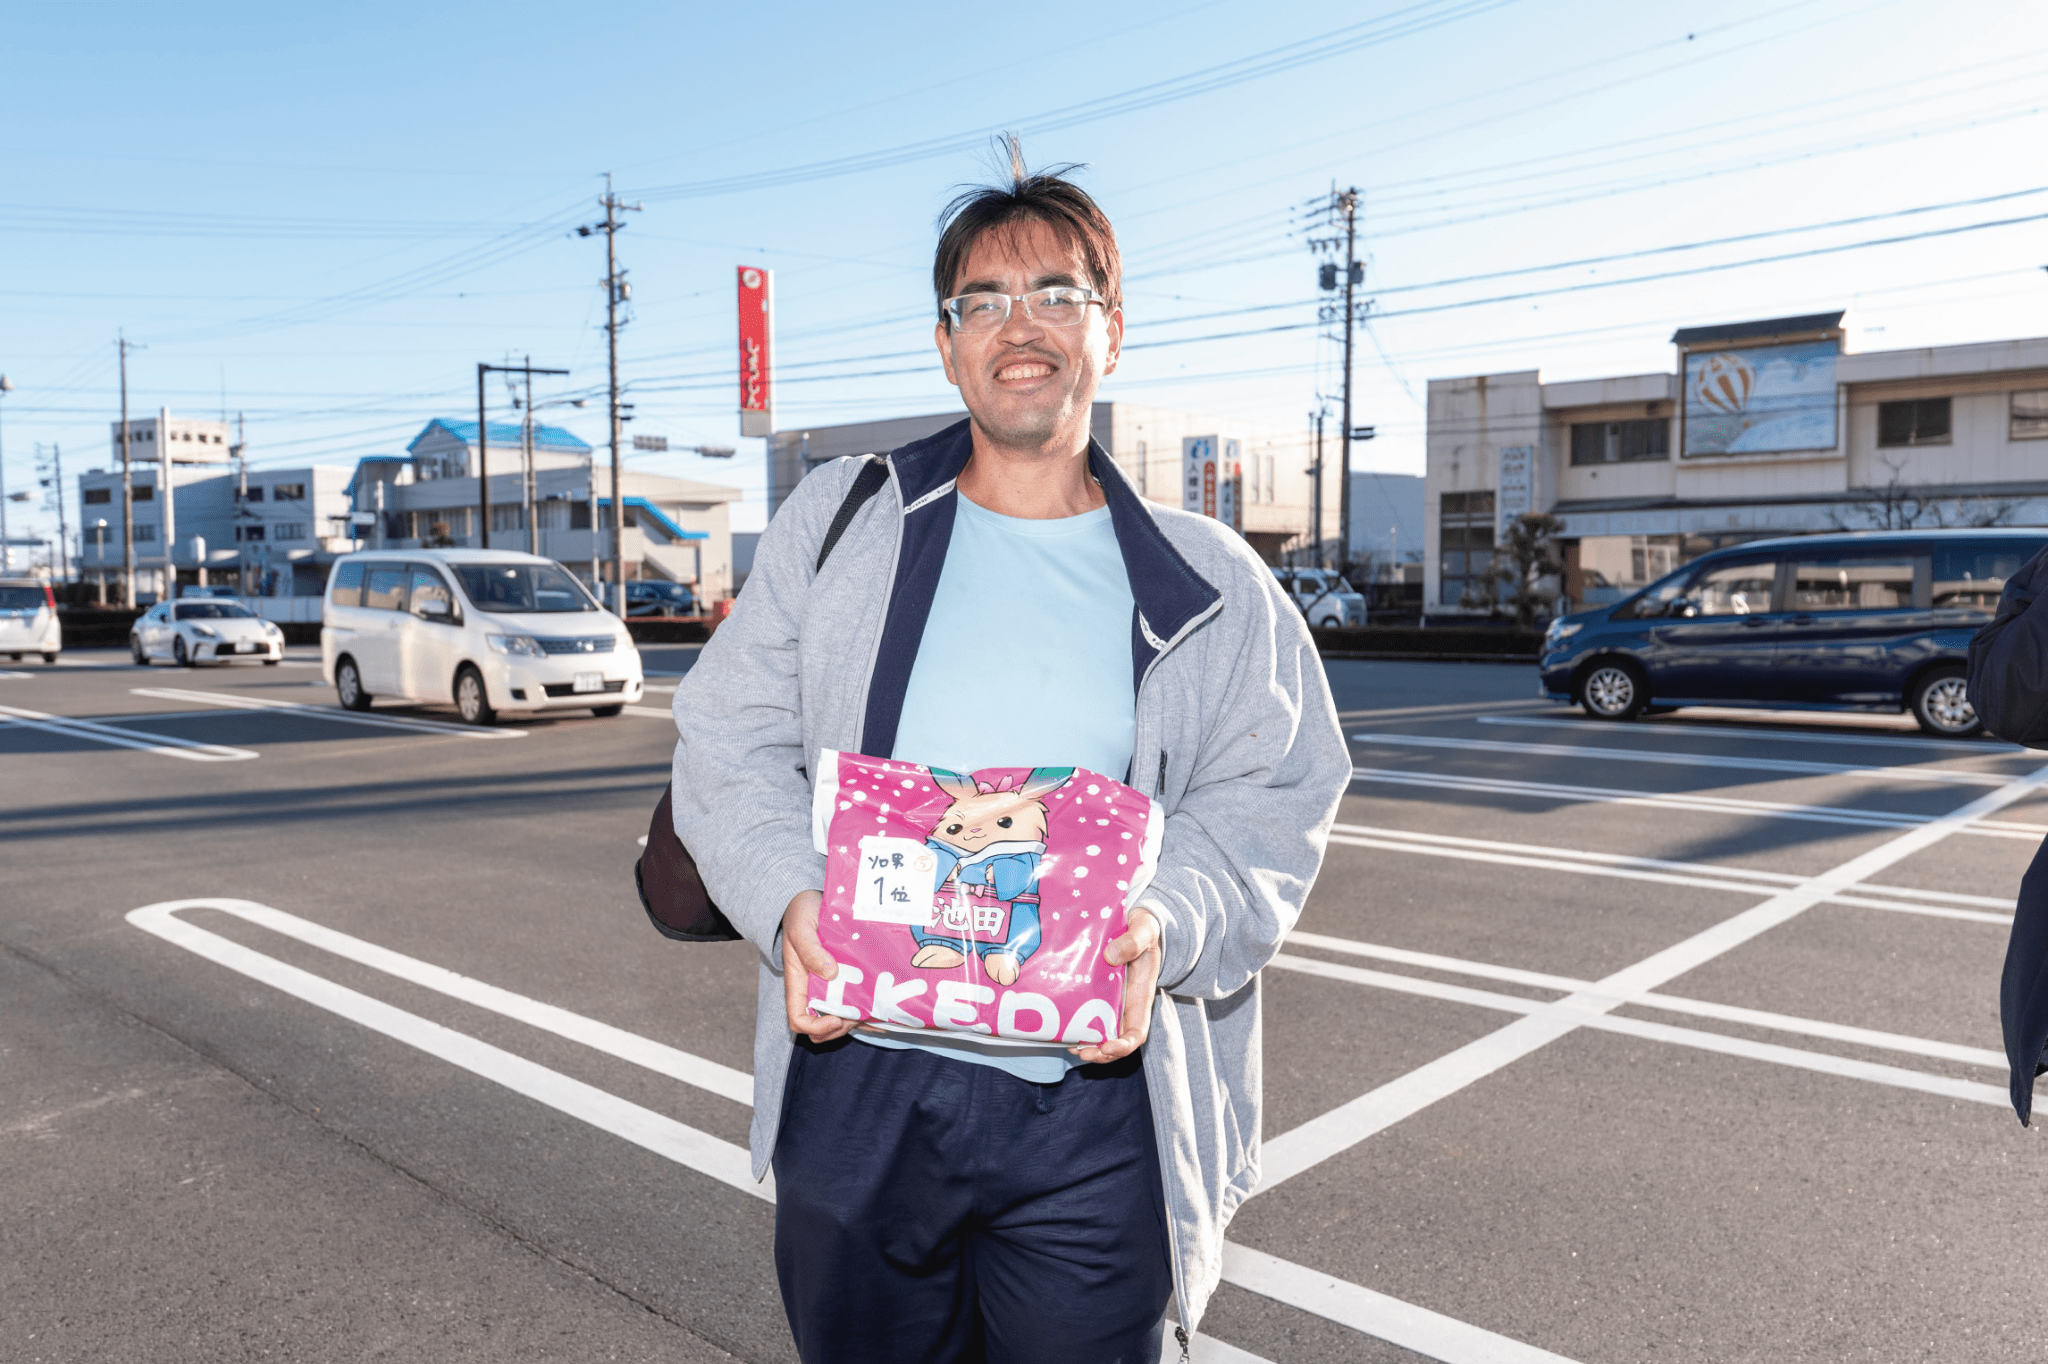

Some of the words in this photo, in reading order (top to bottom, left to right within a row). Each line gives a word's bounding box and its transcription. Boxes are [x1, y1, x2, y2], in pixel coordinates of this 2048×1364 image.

[868, 853, 904, 870] ソロ男
[874, 876, 911, 906] 1位
[931, 897, 1006, 938] 池田
[808, 963, 1117, 1043] IKEDA
